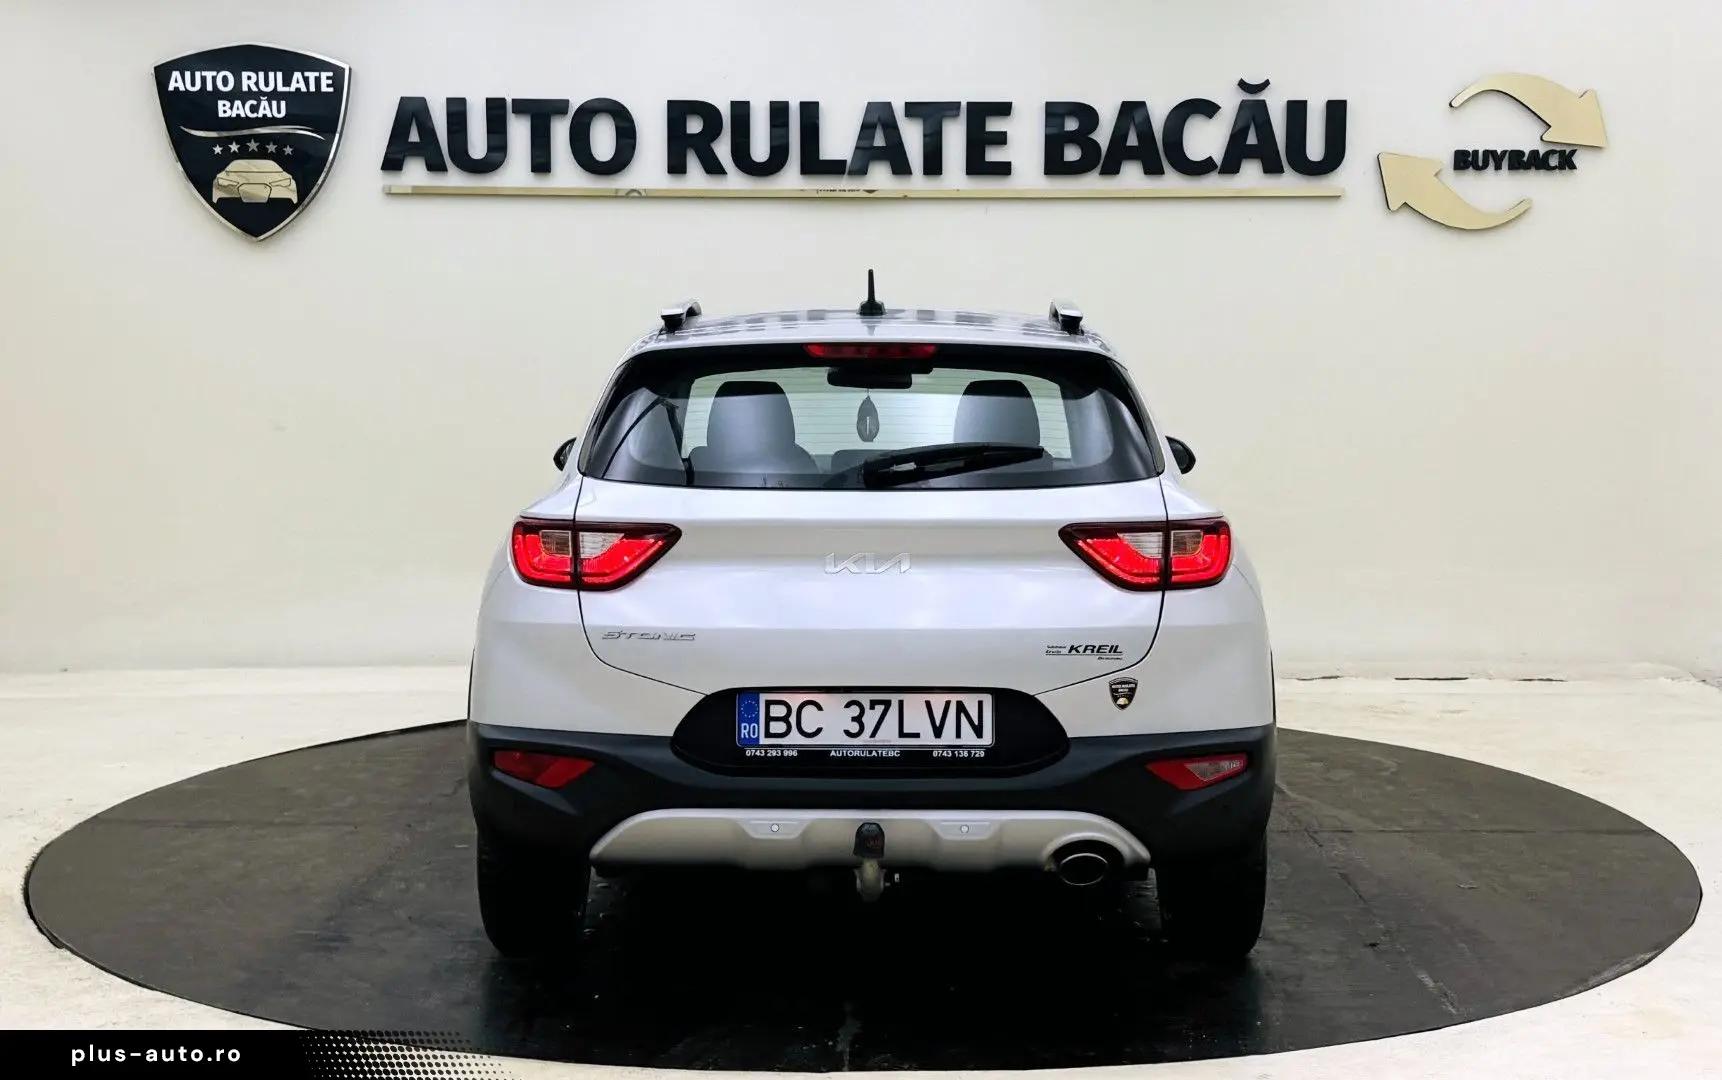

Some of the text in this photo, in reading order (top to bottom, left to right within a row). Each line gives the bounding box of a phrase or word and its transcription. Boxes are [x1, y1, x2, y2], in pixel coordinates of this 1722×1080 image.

[168, 70, 334, 92] AUTO RULATE
[217, 96, 286, 118] BACĂU
[380, 77, 1348, 177] AUTO RULATE BACĂU
[1453, 148, 1578, 171] BUYBACK
[824, 551, 912, 575] KIA
[1067, 644, 1123, 654] KREIL
[763, 699, 824, 739] BC
[740, 722, 759, 739] RO
[745, 749, 798, 757] 0743 293 996
[829, 749, 901, 757] AUTORULATEBC
[932, 750, 952, 758] 0743
[970, 750, 985, 758] 729
